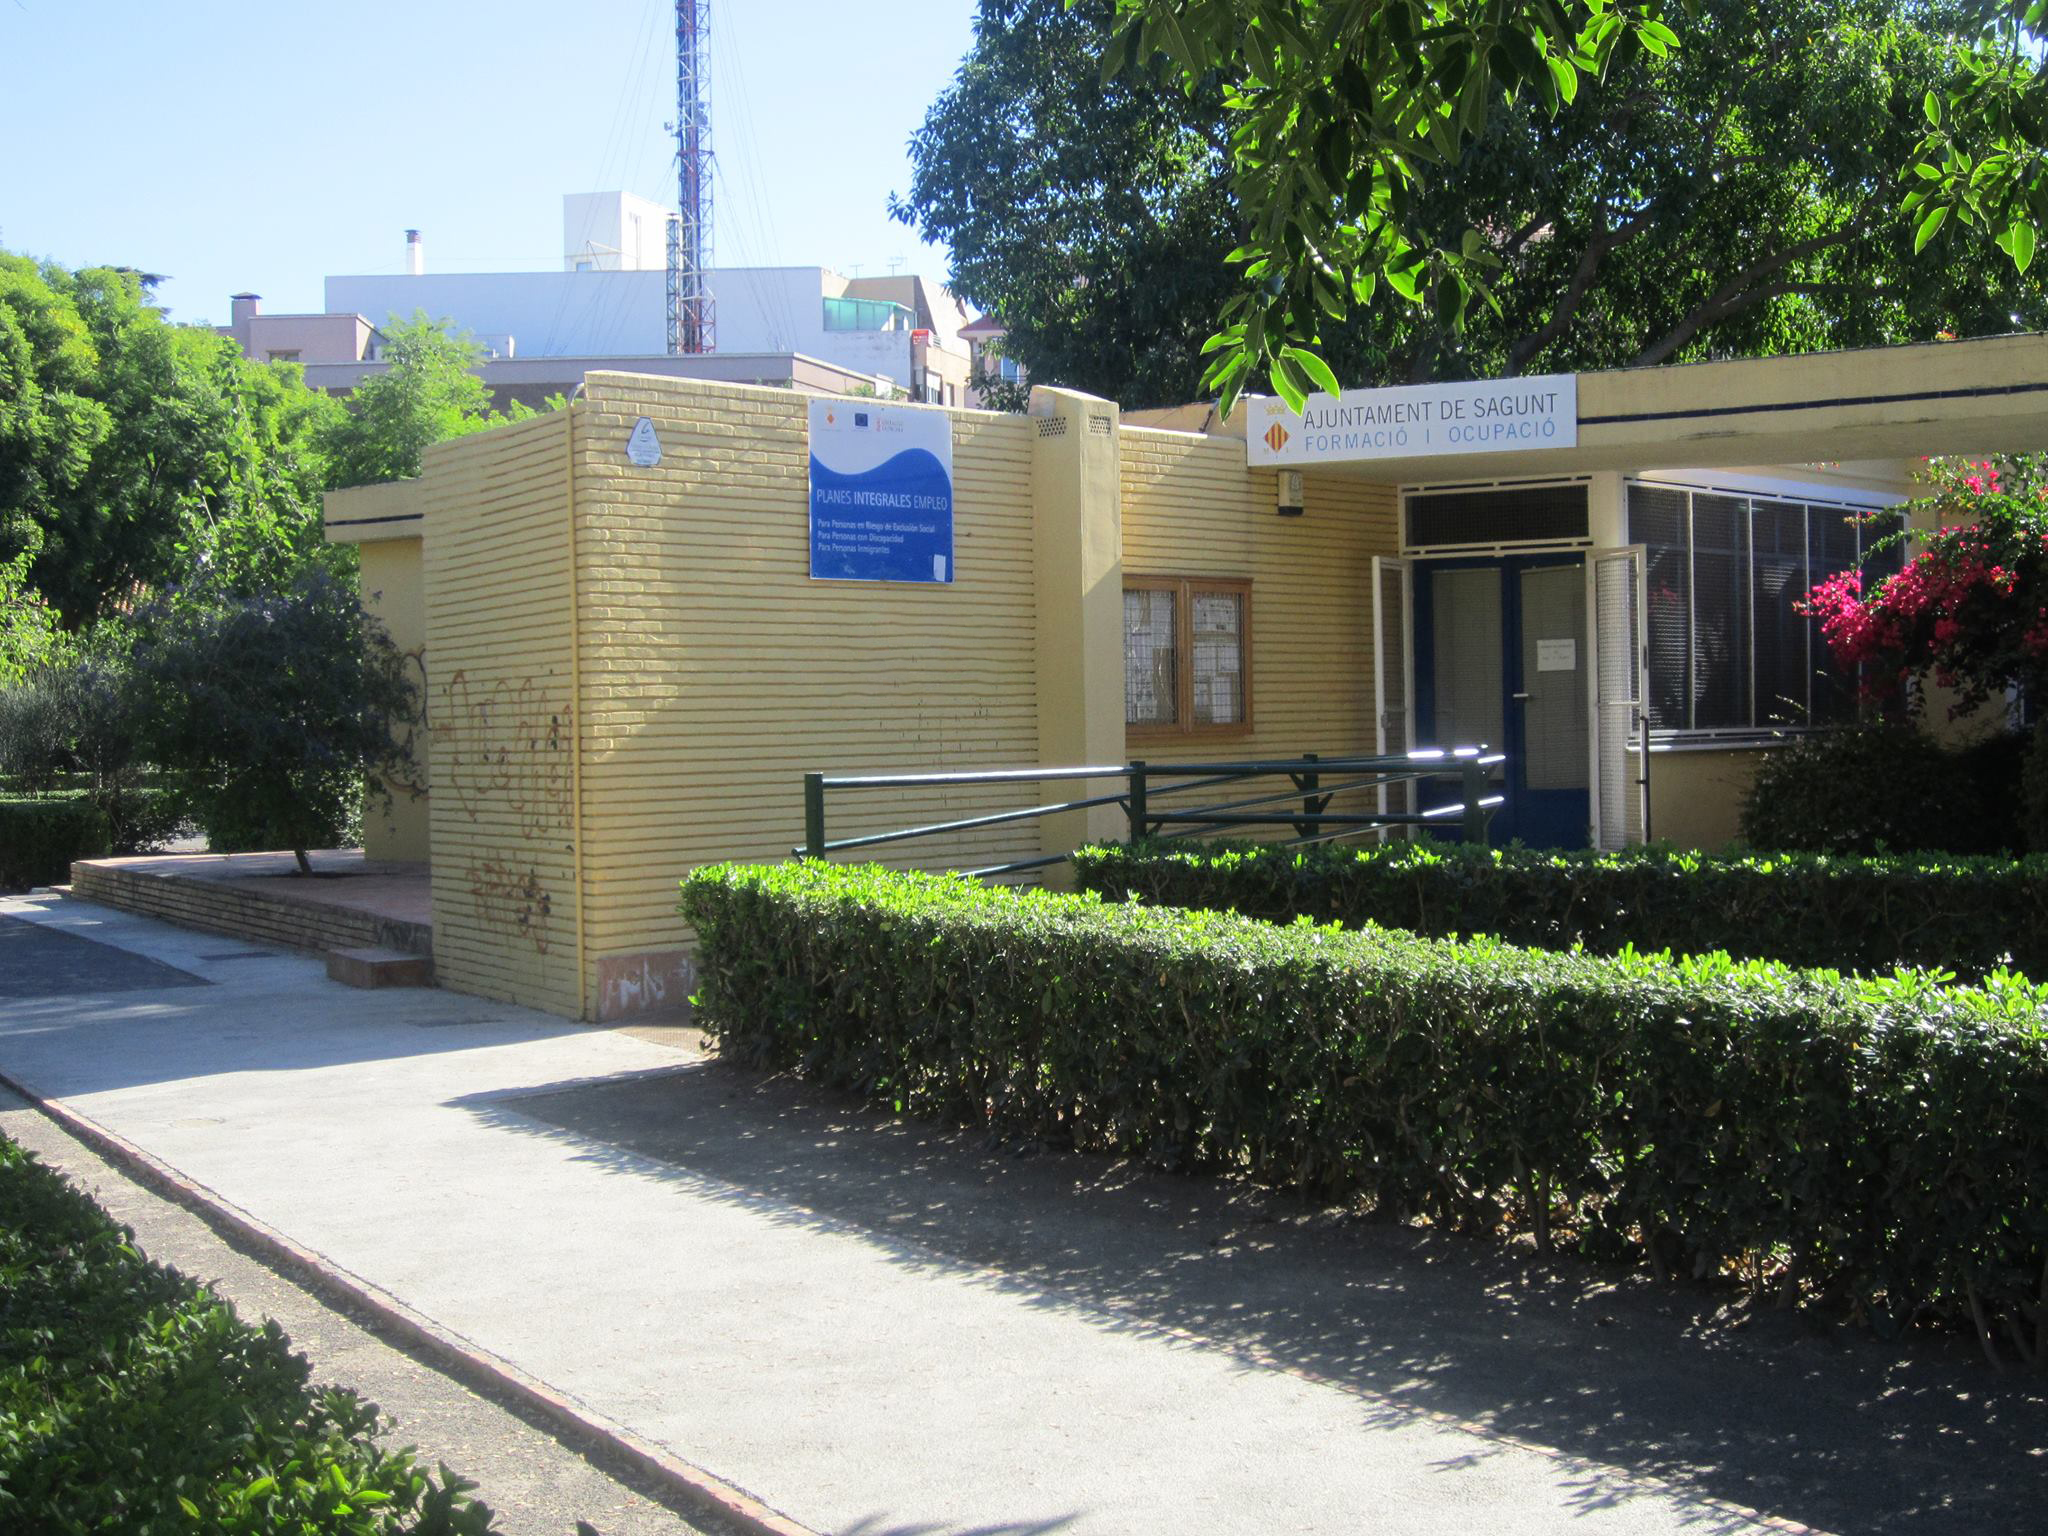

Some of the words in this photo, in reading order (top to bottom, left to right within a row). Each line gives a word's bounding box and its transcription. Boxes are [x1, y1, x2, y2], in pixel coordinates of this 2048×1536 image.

[1304, 401, 1432, 430] AJUNTAMENT
[1441, 399, 1465, 421] DE
[1474, 392, 1558, 418] SAGUNT
[1306, 426, 1408, 452] FORMACIÓ
[1449, 417, 1556, 443] OCUPACIÓ
[816, 488, 851, 505] PLANES
[854, 491, 912, 509] INTEGRALES
[913, 495, 948, 511] EMPLEO
[817, 518, 830, 528] Para
[832, 519, 856, 529] Personas
[866, 520, 883, 532] Riesgo
[885, 522, 891, 530] de
[893, 521, 918, 532] Exclusión
[919, 523, 935, 533] Social
[817, 530, 830, 539] Para
[832, 531, 856, 541] Personas
[869, 532, 904, 544] Discapacidad
[817, 542, 830, 552] Para
[832, 543, 856, 553] Personas
[857, 544, 890, 555] Inmigrantes
